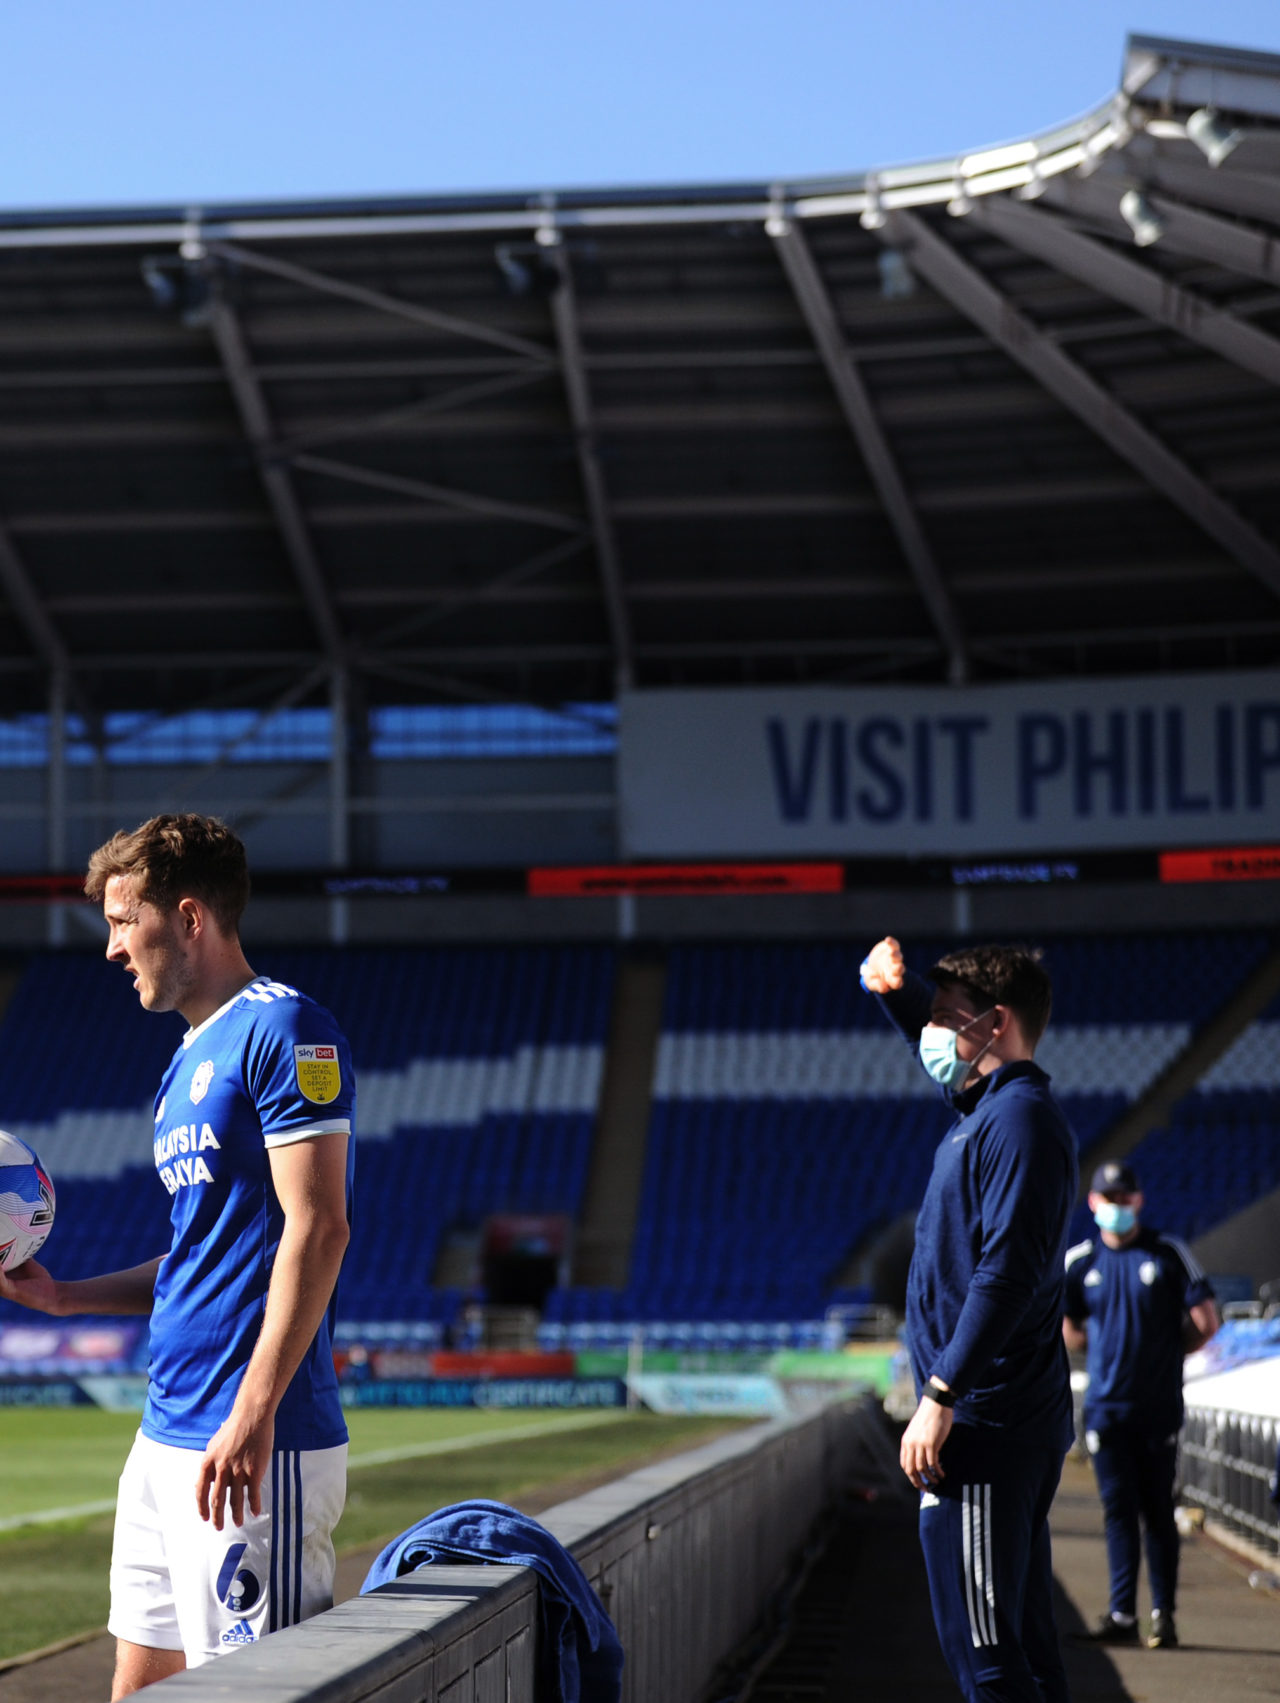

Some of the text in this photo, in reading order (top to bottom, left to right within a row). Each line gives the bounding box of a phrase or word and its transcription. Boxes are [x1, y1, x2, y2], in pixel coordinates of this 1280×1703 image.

[766, 704, 1280, 826] VISIT PHILIP
[298, 1048, 332, 1058] sky bet
[216, 1543, 260, 1612] 6
